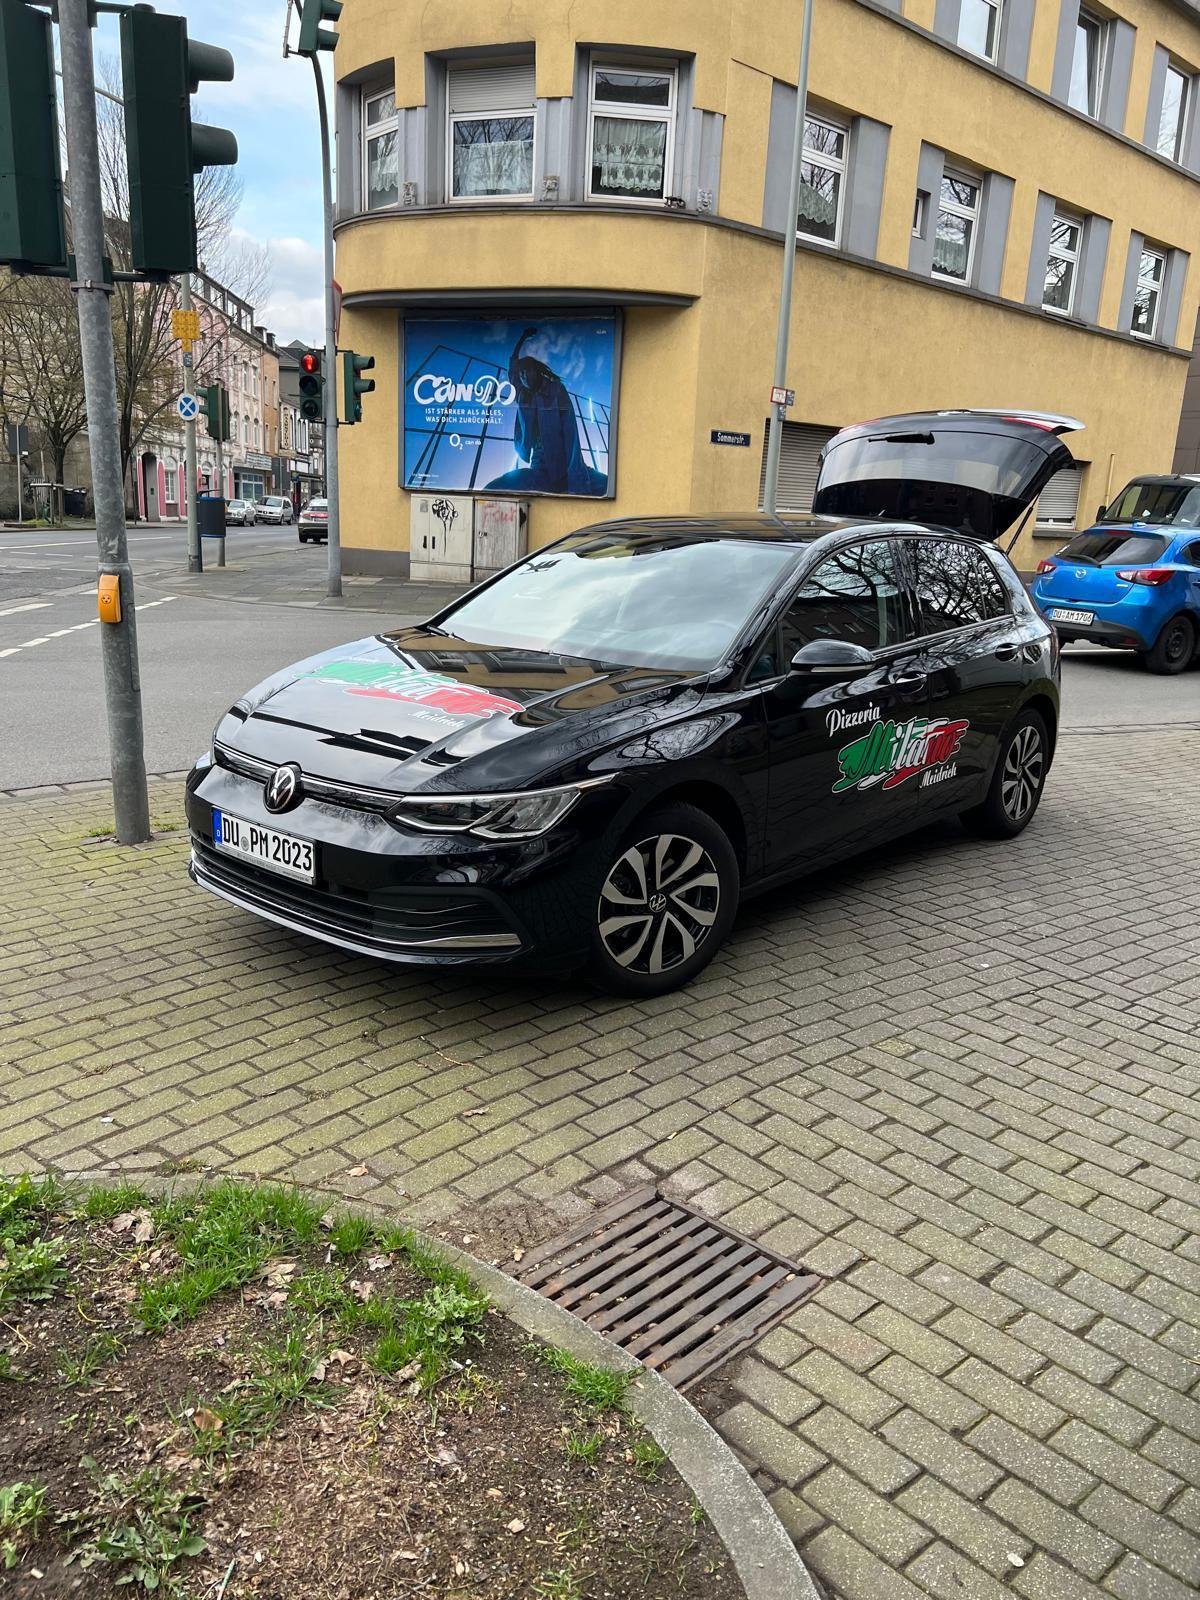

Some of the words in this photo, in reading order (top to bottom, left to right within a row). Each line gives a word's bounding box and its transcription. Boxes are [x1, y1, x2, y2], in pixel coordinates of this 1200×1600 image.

[436, 407, 465, 416] STÄRKER
[467, 408, 480, 416] ALS
[481, 409, 504, 417] ALLES,
[441, 416, 458, 424] DICH
[459, 416, 504, 425] ZURÜCKHÄLT.
[1053, 609, 1062, 619] DU
[1065, 611, 1075, 620] AM
[1075, 612, 1092, 623] 1706
[825, 701, 882, 738] Pizzeria
[842, 716, 961, 782] Milano
[222, 817, 240, 847] DU
[250, 827, 269, 858] PM
[272, 835, 312, 871] 2023
